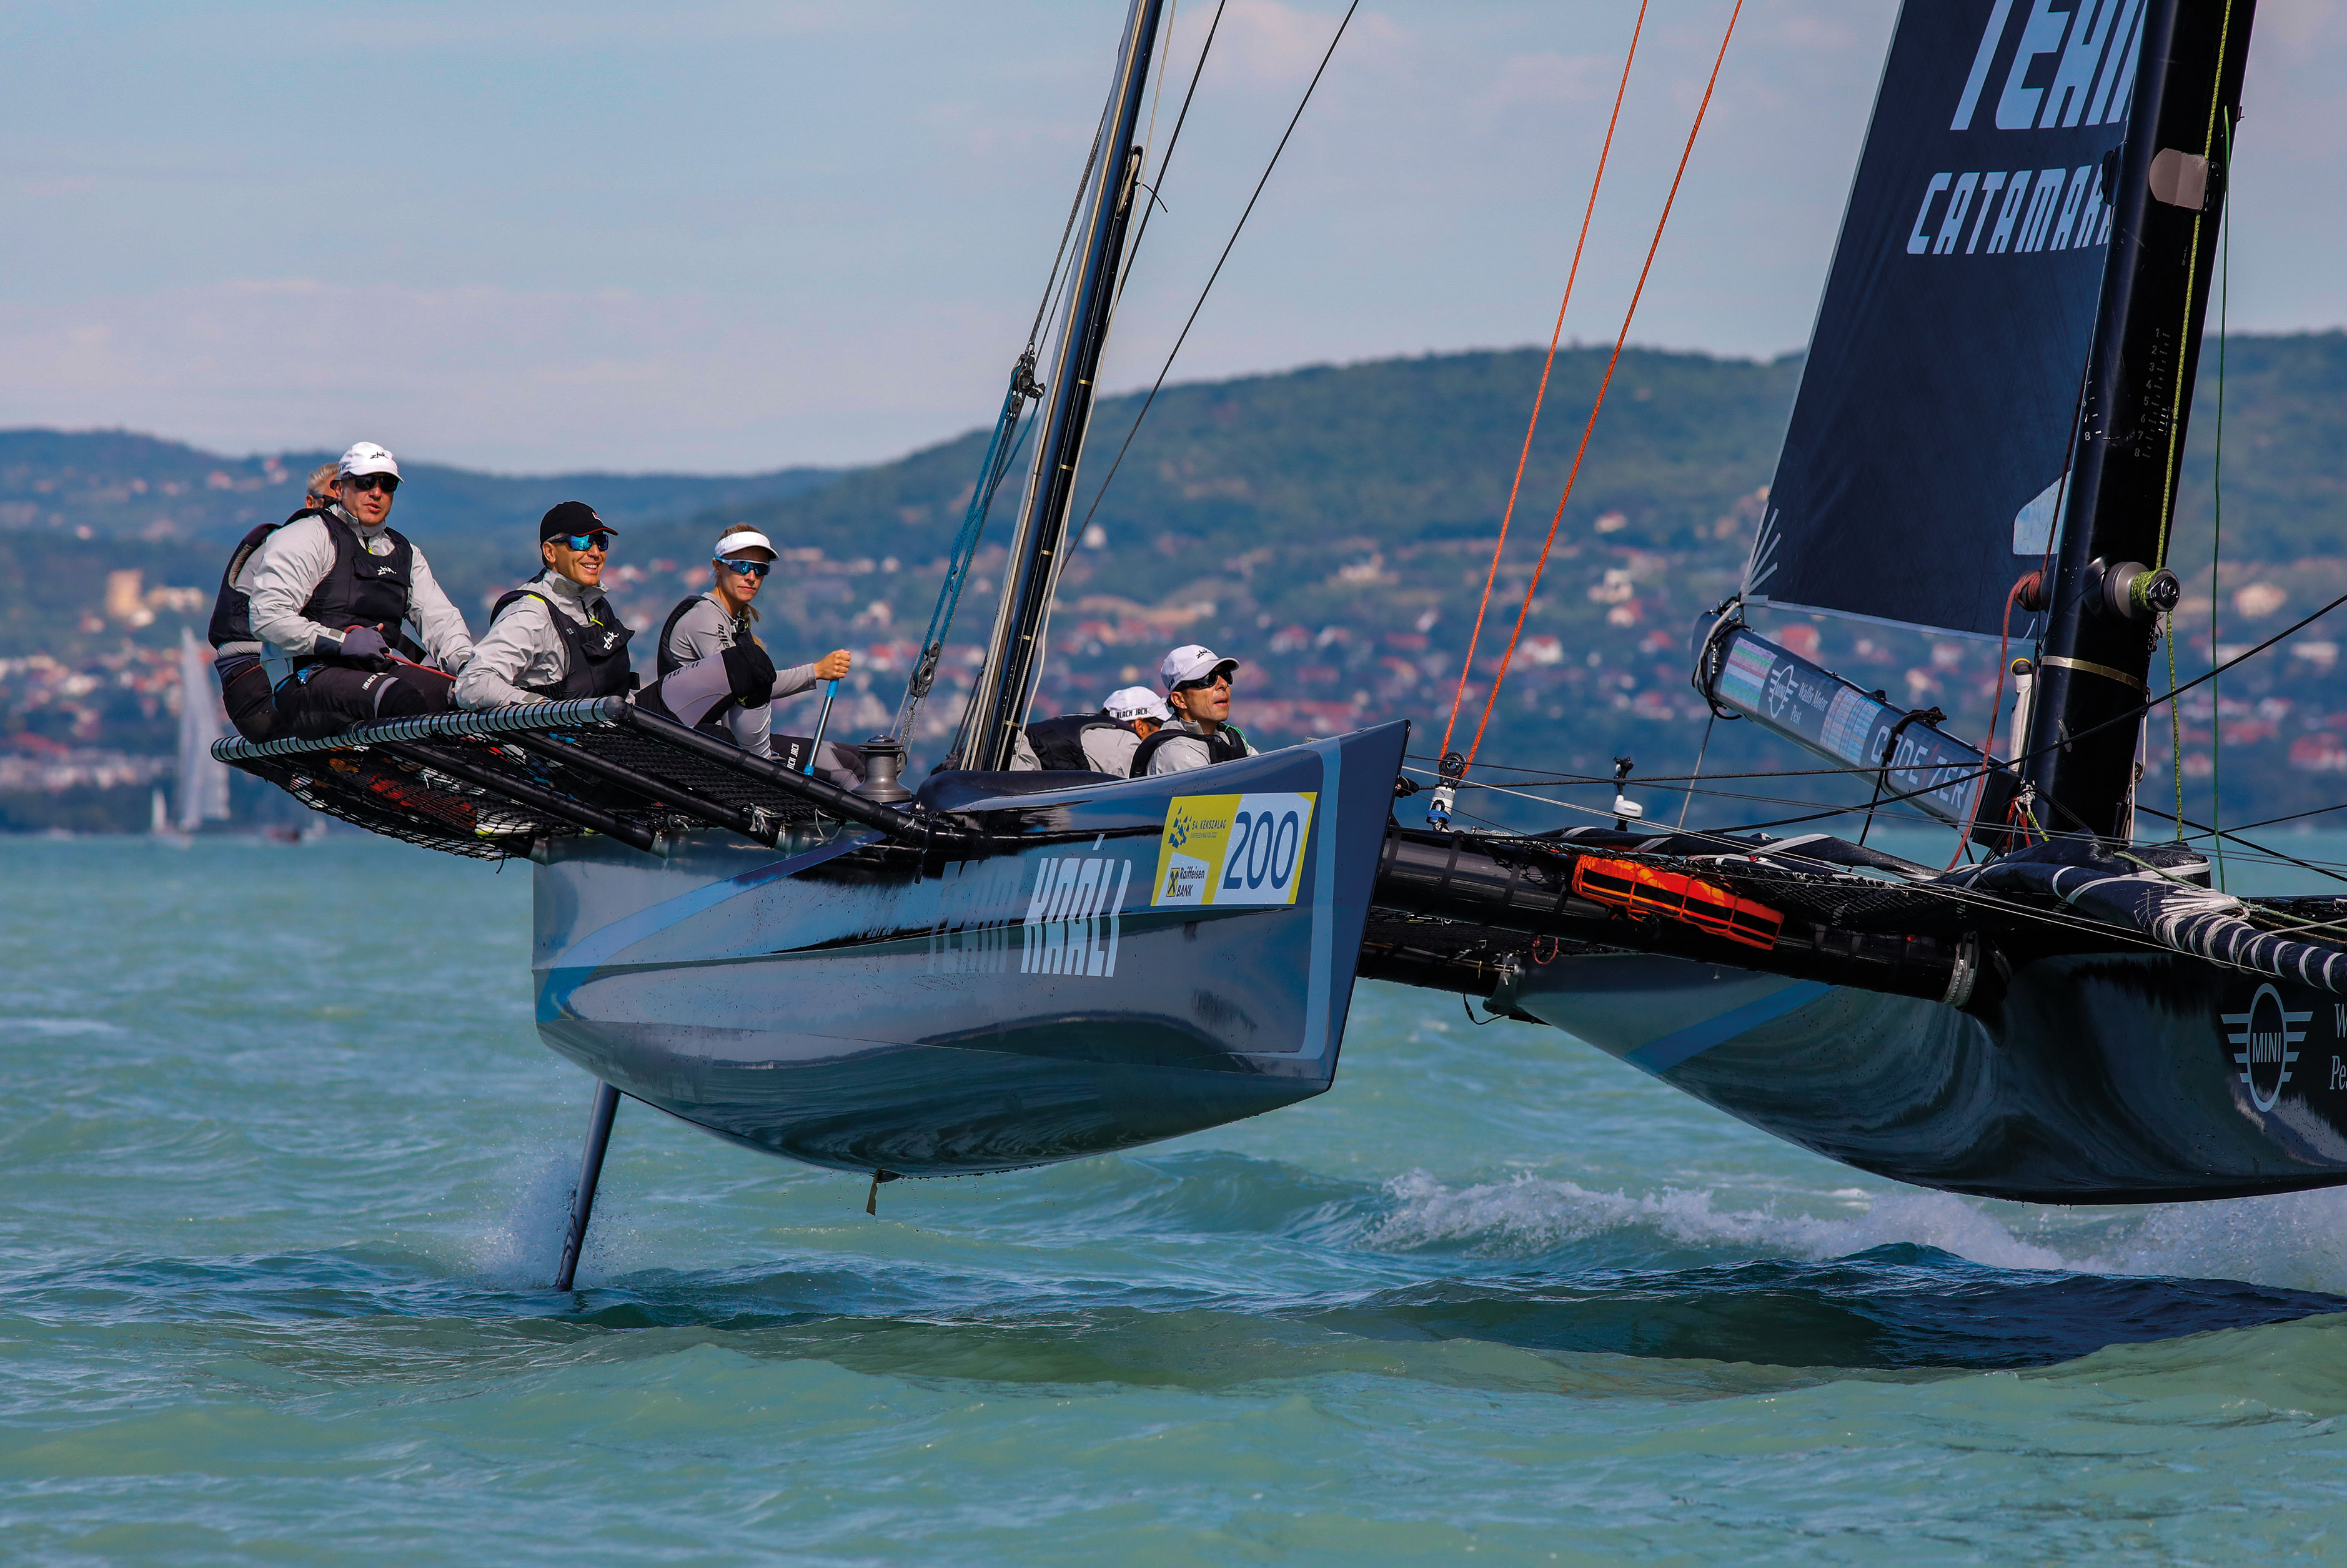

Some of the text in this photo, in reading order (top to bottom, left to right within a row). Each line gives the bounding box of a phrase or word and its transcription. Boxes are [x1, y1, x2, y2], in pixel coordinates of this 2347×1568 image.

[1798, 682, 1828, 712] Wallis Motor
[1116, 708, 1148, 719] BLACK JACK
[1790, 705, 1802, 725] Pest
[787, 757, 796, 770] ACK
[1223, 810, 1299, 890] 200
[1179, 866, 1205, 880] Raiffeisen
[1176, 884, 1194, 897] BANK
[2253, 1032, 2281, 1063] MINI
[2330, 1055, 2347, 1090] Pe
